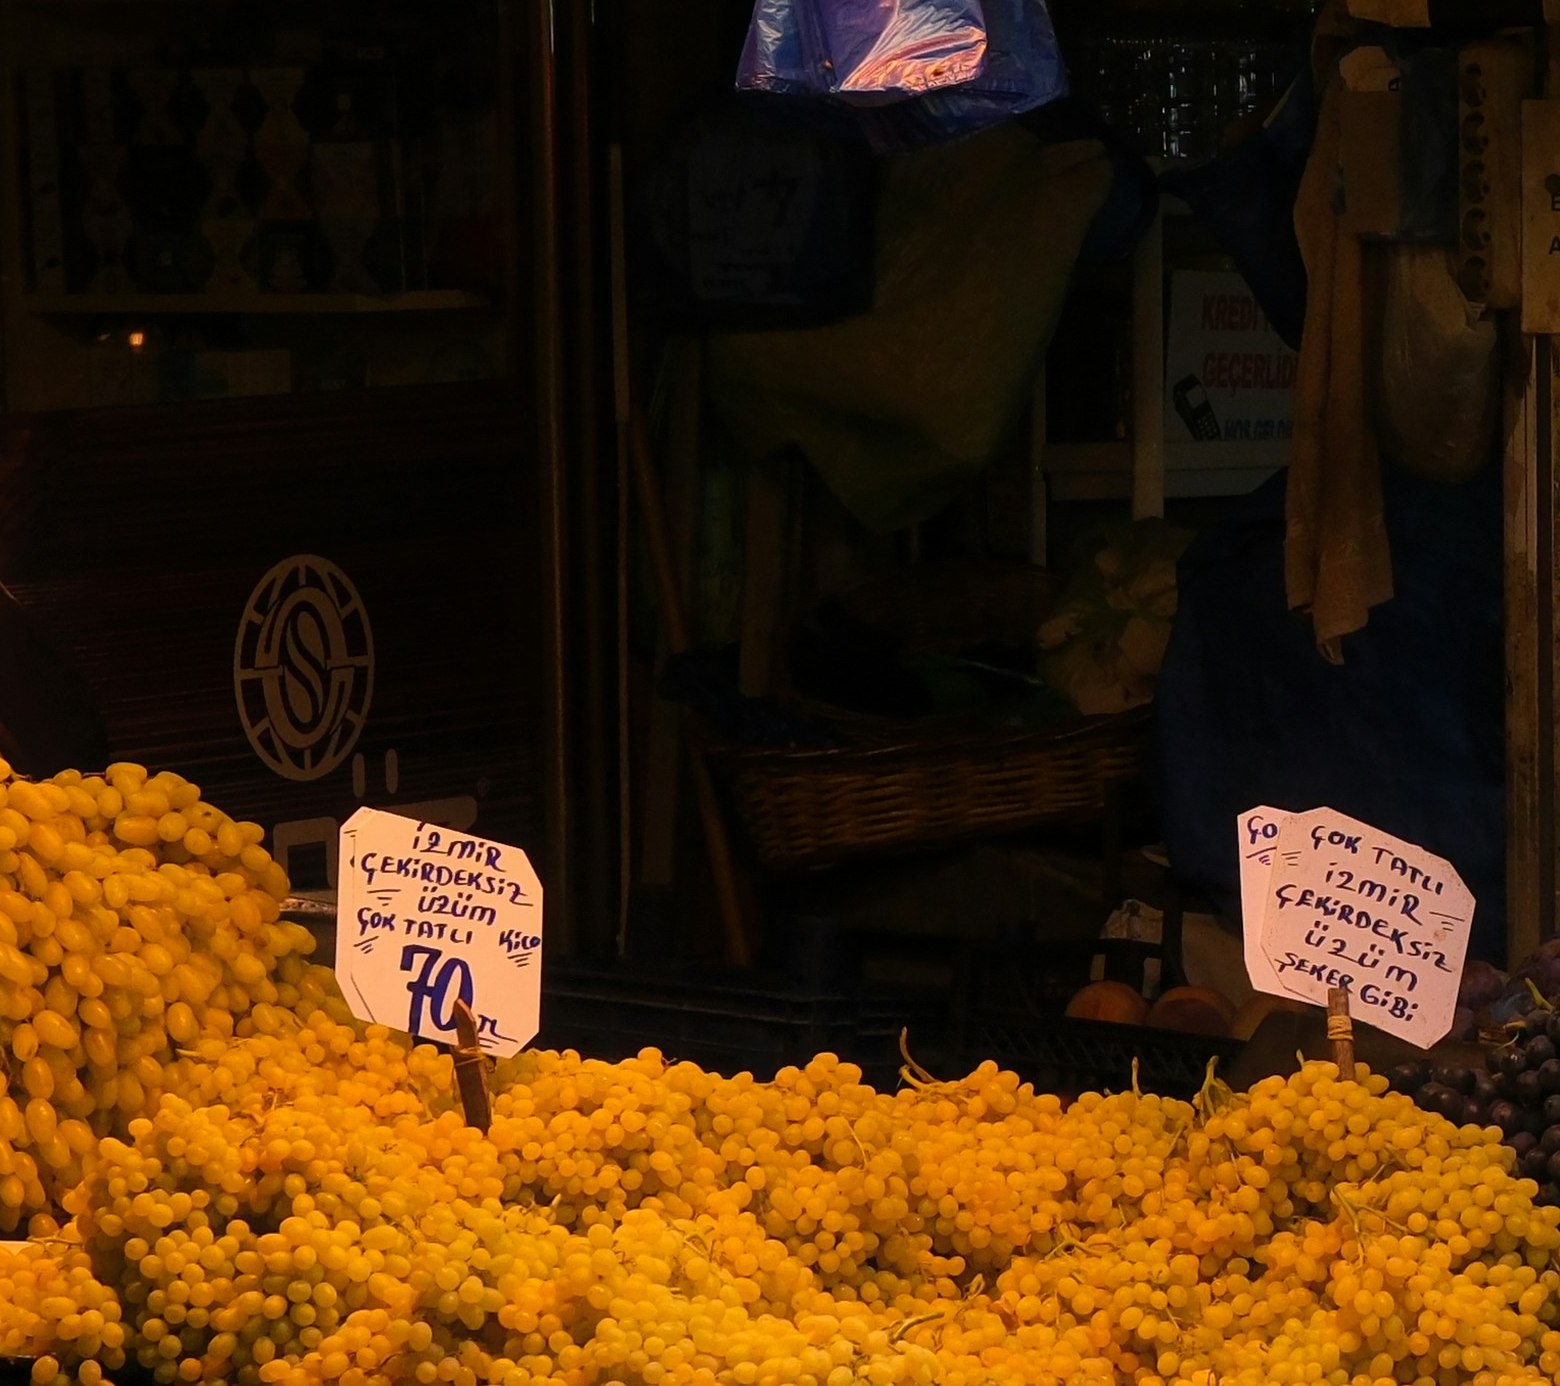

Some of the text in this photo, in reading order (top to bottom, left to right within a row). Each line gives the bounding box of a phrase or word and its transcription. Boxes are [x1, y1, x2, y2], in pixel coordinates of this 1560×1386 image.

[413, 821, 507, 873] İZMİR
[1246, 815, 1279, 845] ÇO
[1310, 825, 1445, 896] ÇOK TATLI
[360, 852, 535, 907] ÇEKİRDEKSİZ
[417, 886, 497, 926] ÜZÜM
[1325, 861, 1423, 927] İZMİR
[357, 907, 396, 936] ÇOK
[403, 919, 474, 945] TATLI
[1275, 884, 1453, 974] ÇEKİRDEKSİZ
[1304, 920, 1419, 993] ÜZÜM
[400, 944, 474, 1036] 70
[1274, 951, 1420, 1022] ŞEKER GİBİ
